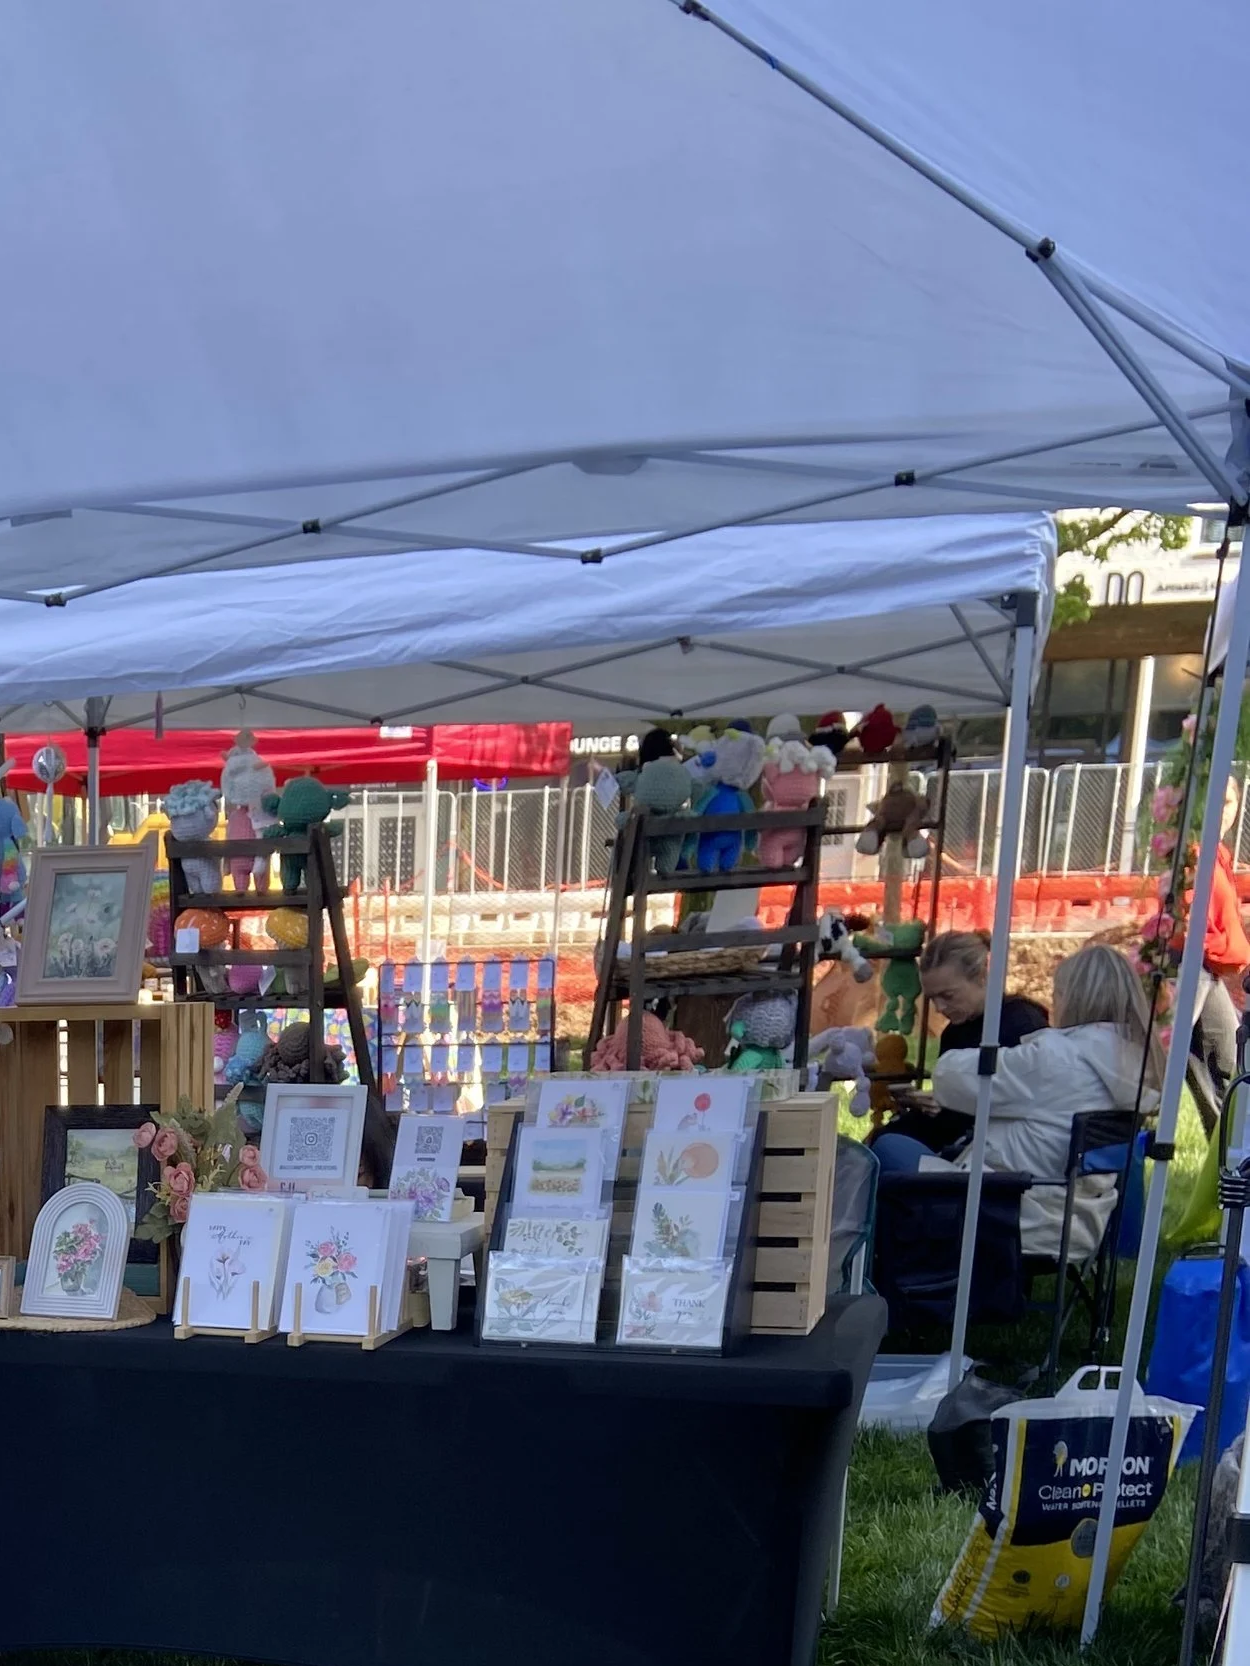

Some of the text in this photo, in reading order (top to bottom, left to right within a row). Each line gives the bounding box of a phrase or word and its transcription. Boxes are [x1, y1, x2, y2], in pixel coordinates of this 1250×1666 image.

[626, 735, 639, 752] &
[1069, 1456, 1151, 1477] MORON
[1038, 1482, 1153, 1500] Clean Ptect
[1117, 1499, 1147, 1509] ELLETS
